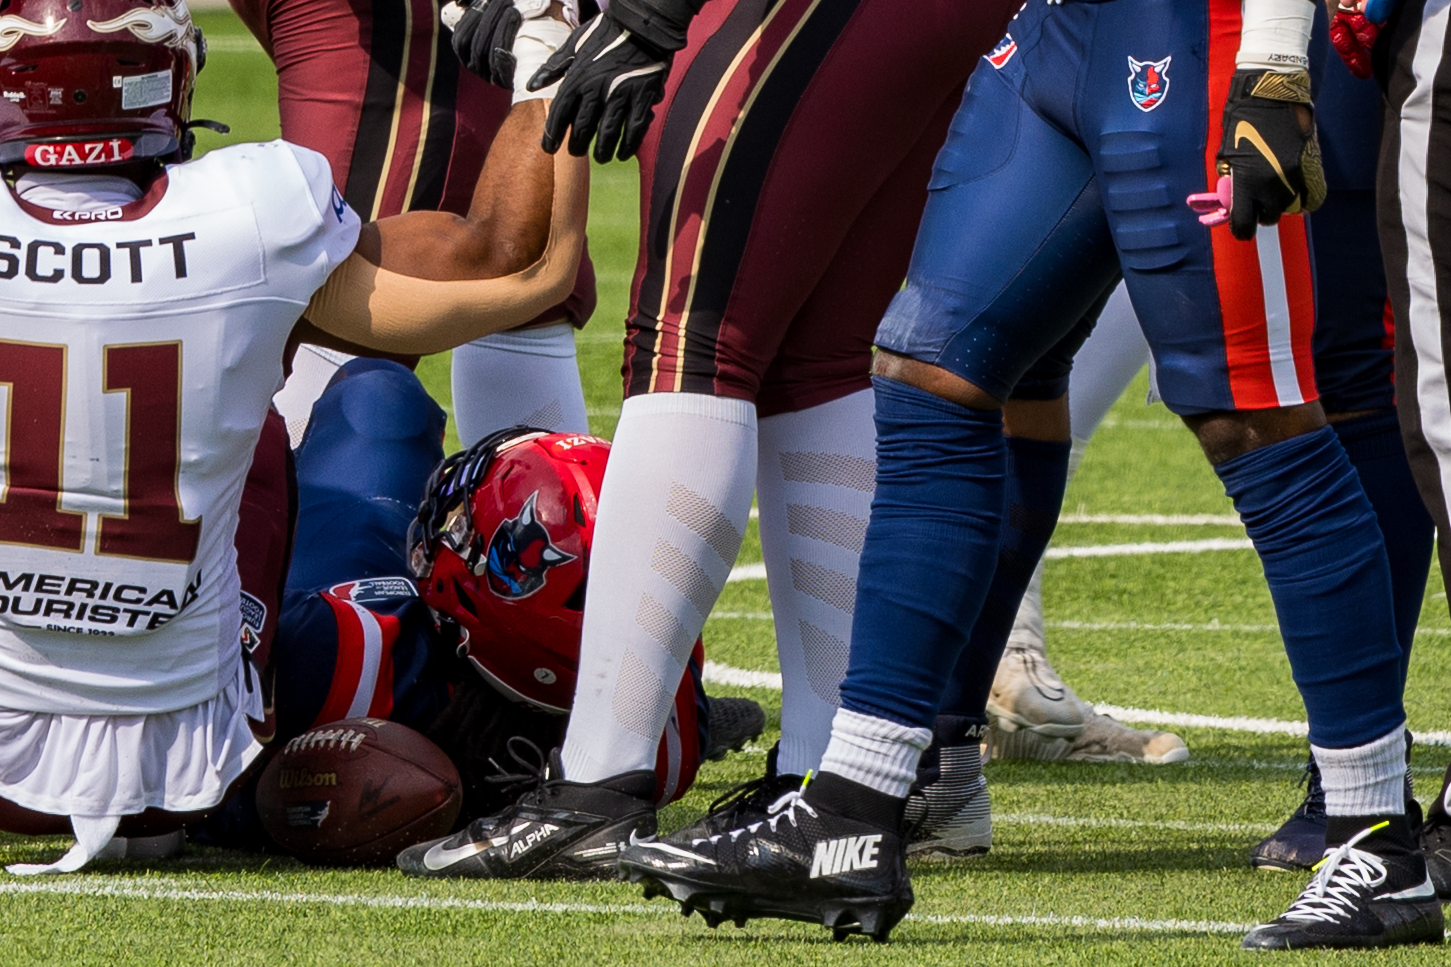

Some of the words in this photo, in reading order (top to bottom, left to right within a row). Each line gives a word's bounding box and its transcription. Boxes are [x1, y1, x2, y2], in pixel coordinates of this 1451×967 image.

[280, 767, 337, 789] Wilson
[510, 823, 560, 859] ALPHA
[809, 834, 883, 879] NIKE
